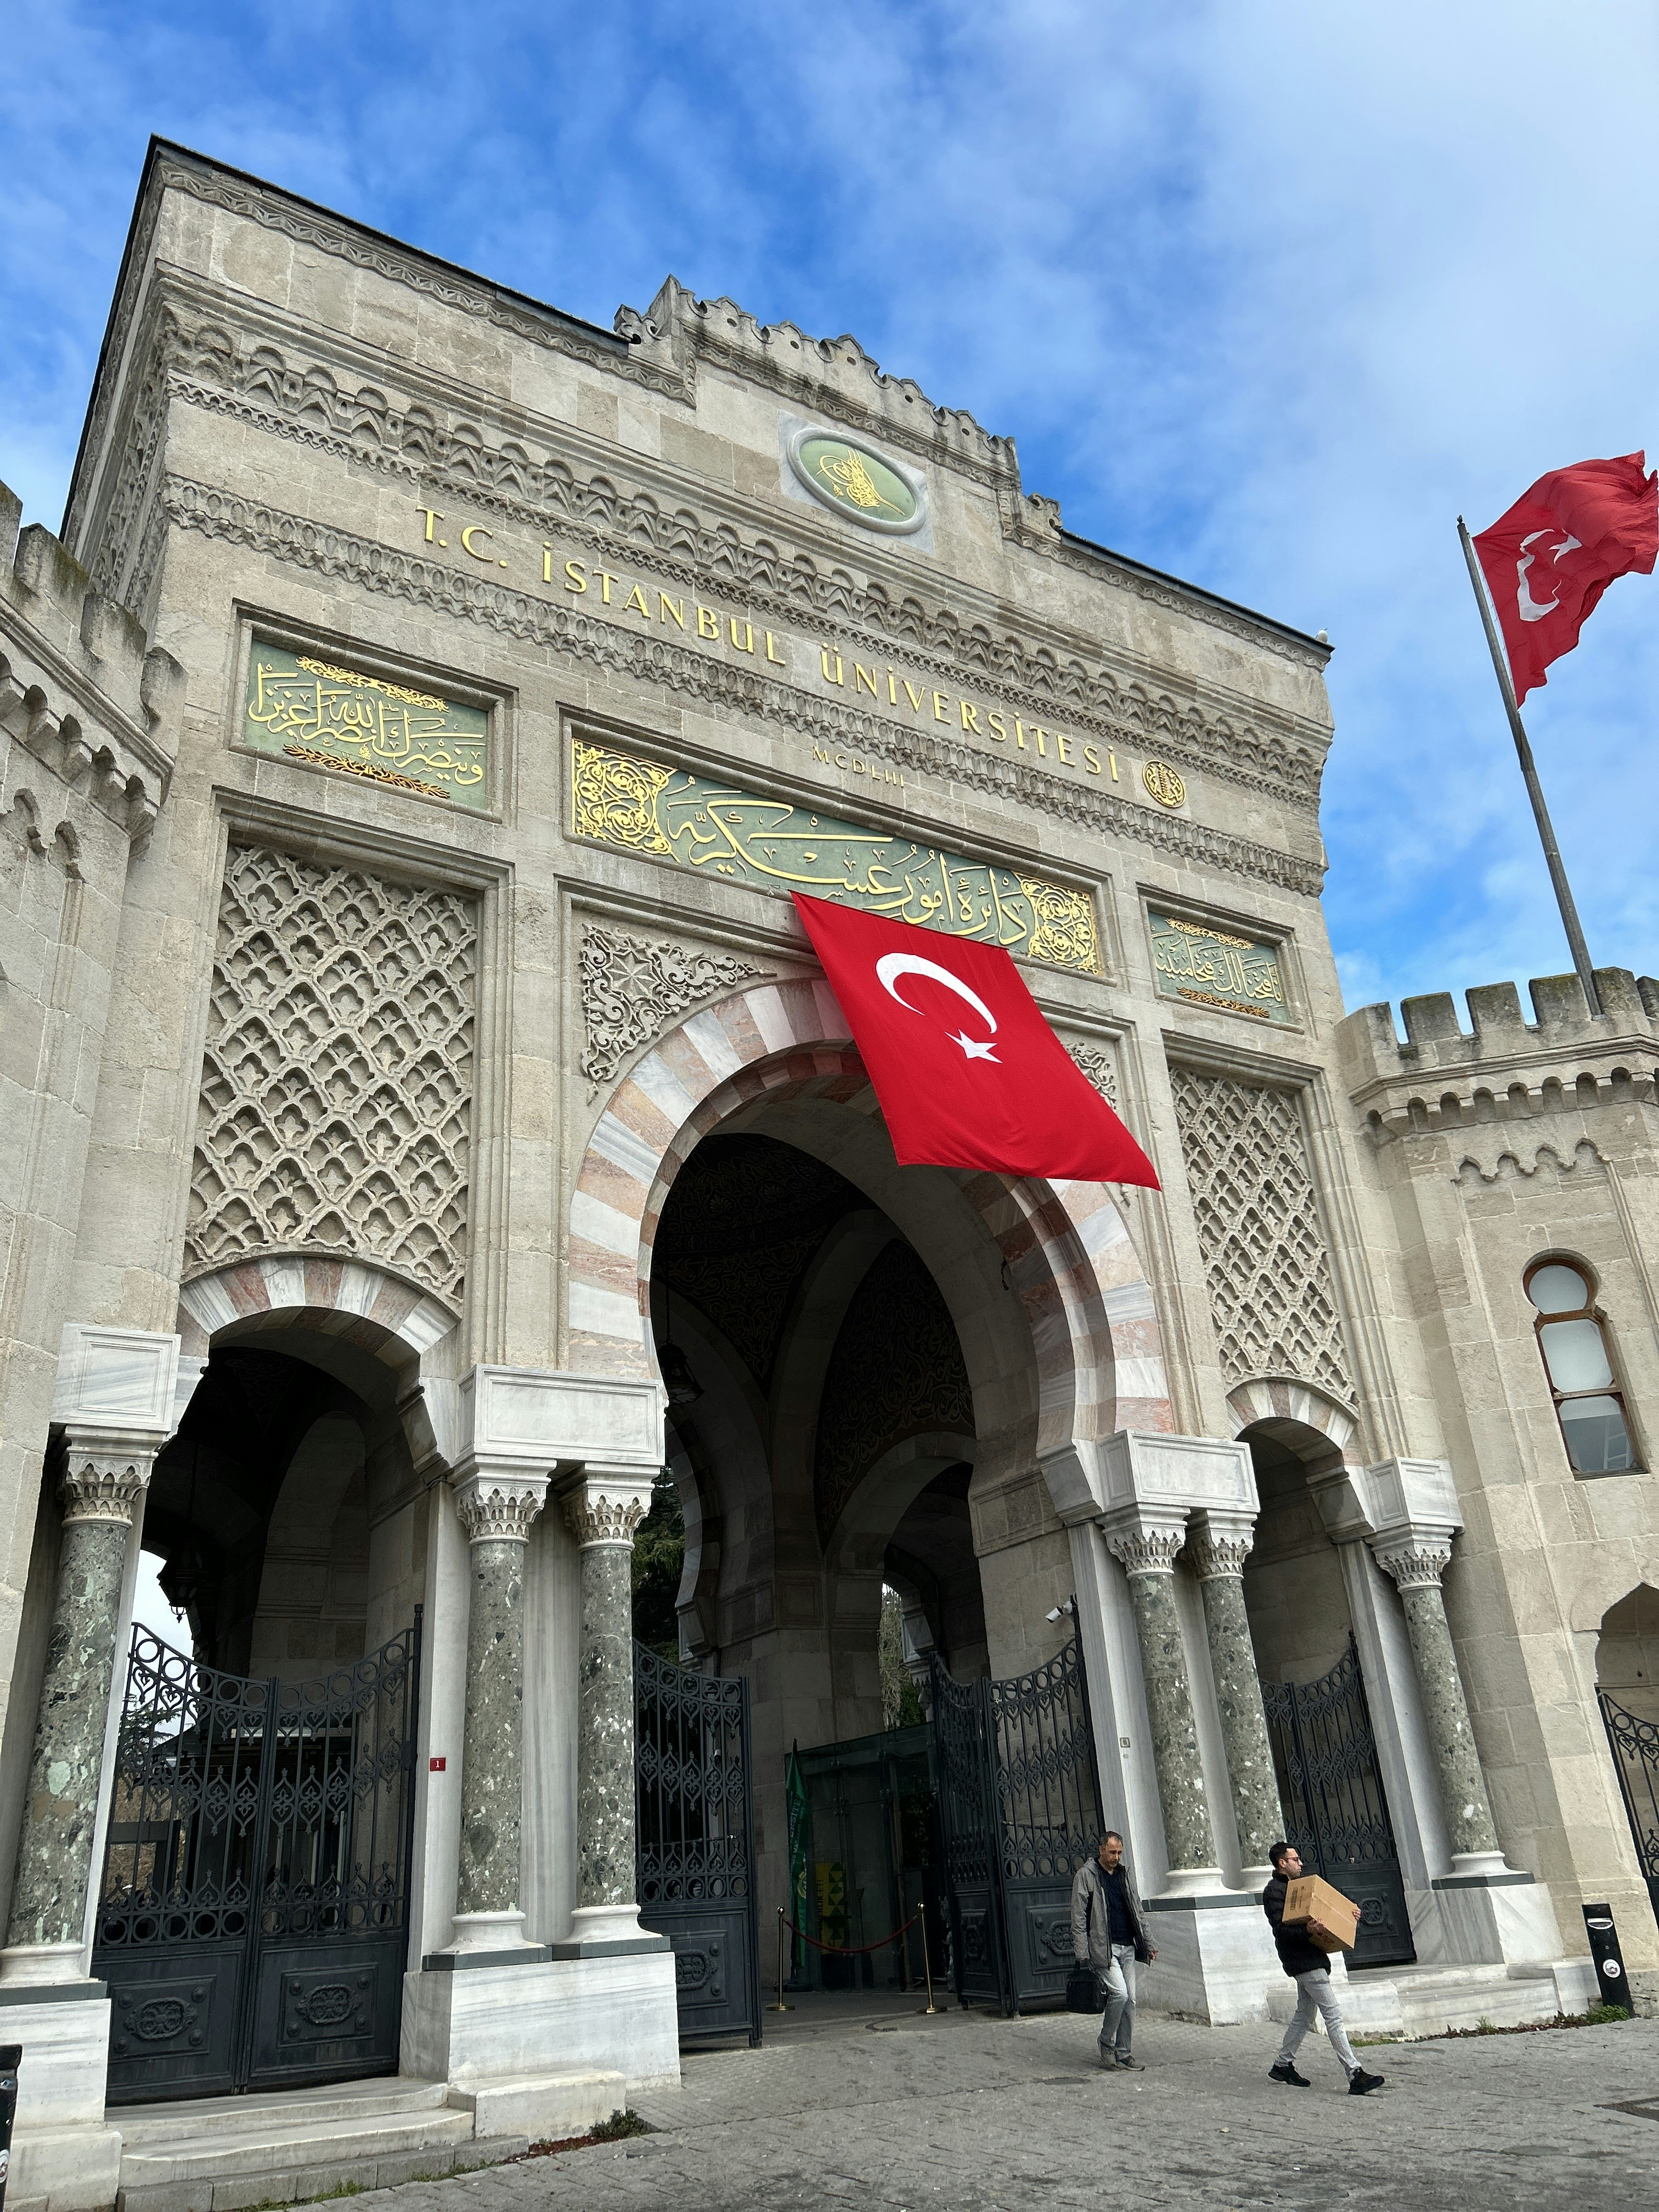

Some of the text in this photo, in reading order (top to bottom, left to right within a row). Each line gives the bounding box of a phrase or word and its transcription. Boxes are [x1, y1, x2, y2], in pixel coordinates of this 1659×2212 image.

[541, 541, 786, 665] İSTANBUL
[820, 642, 1120, 783] ÜNİVERSİTESİ
[812, 746, 904, 788] MCDLIII
[436, 1760, 440, 1768] 1
